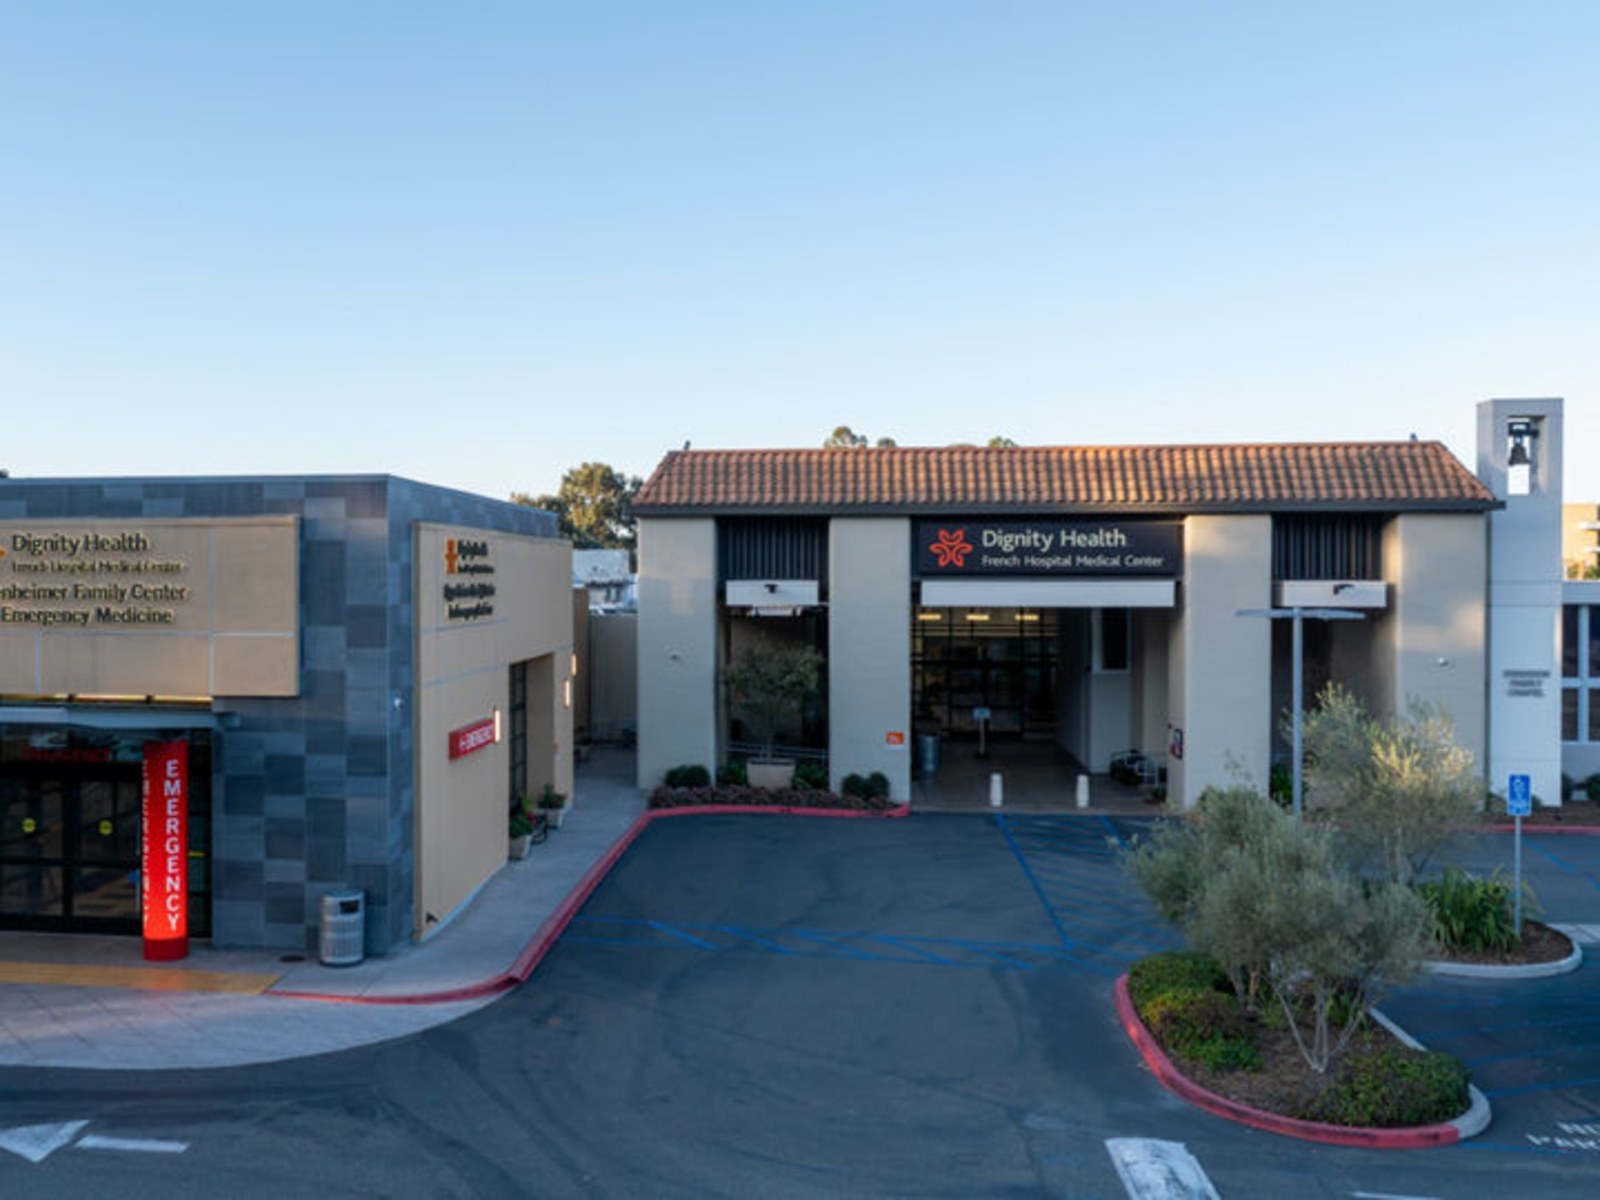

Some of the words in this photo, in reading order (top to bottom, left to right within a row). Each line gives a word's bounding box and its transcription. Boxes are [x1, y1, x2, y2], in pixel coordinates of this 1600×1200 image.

[12, 533, 80, 555] Dignity
[83, 533, 149, 551] Health
[982, 528, 1054, 551] Dignity
[1060, 528, 1126, 547] Health
[982, 555, 1021, 567] French
[1024, 555, 1072, 569] Hospital
[1076, 555, 1121, 567] Medical
[1124, 556, 1164, 567] Center
[0, 583, 68, 600] nheimer
[73, 583, 128, 603] Family
[131, 584, 187, 600] Center
[2, 606, 90, 626] Emergency
[96, 606, 174, 624] Medicine
[164, 760, 181, 931] EMERGENCY
[1525, 1134, 1600, 1149] PAR
